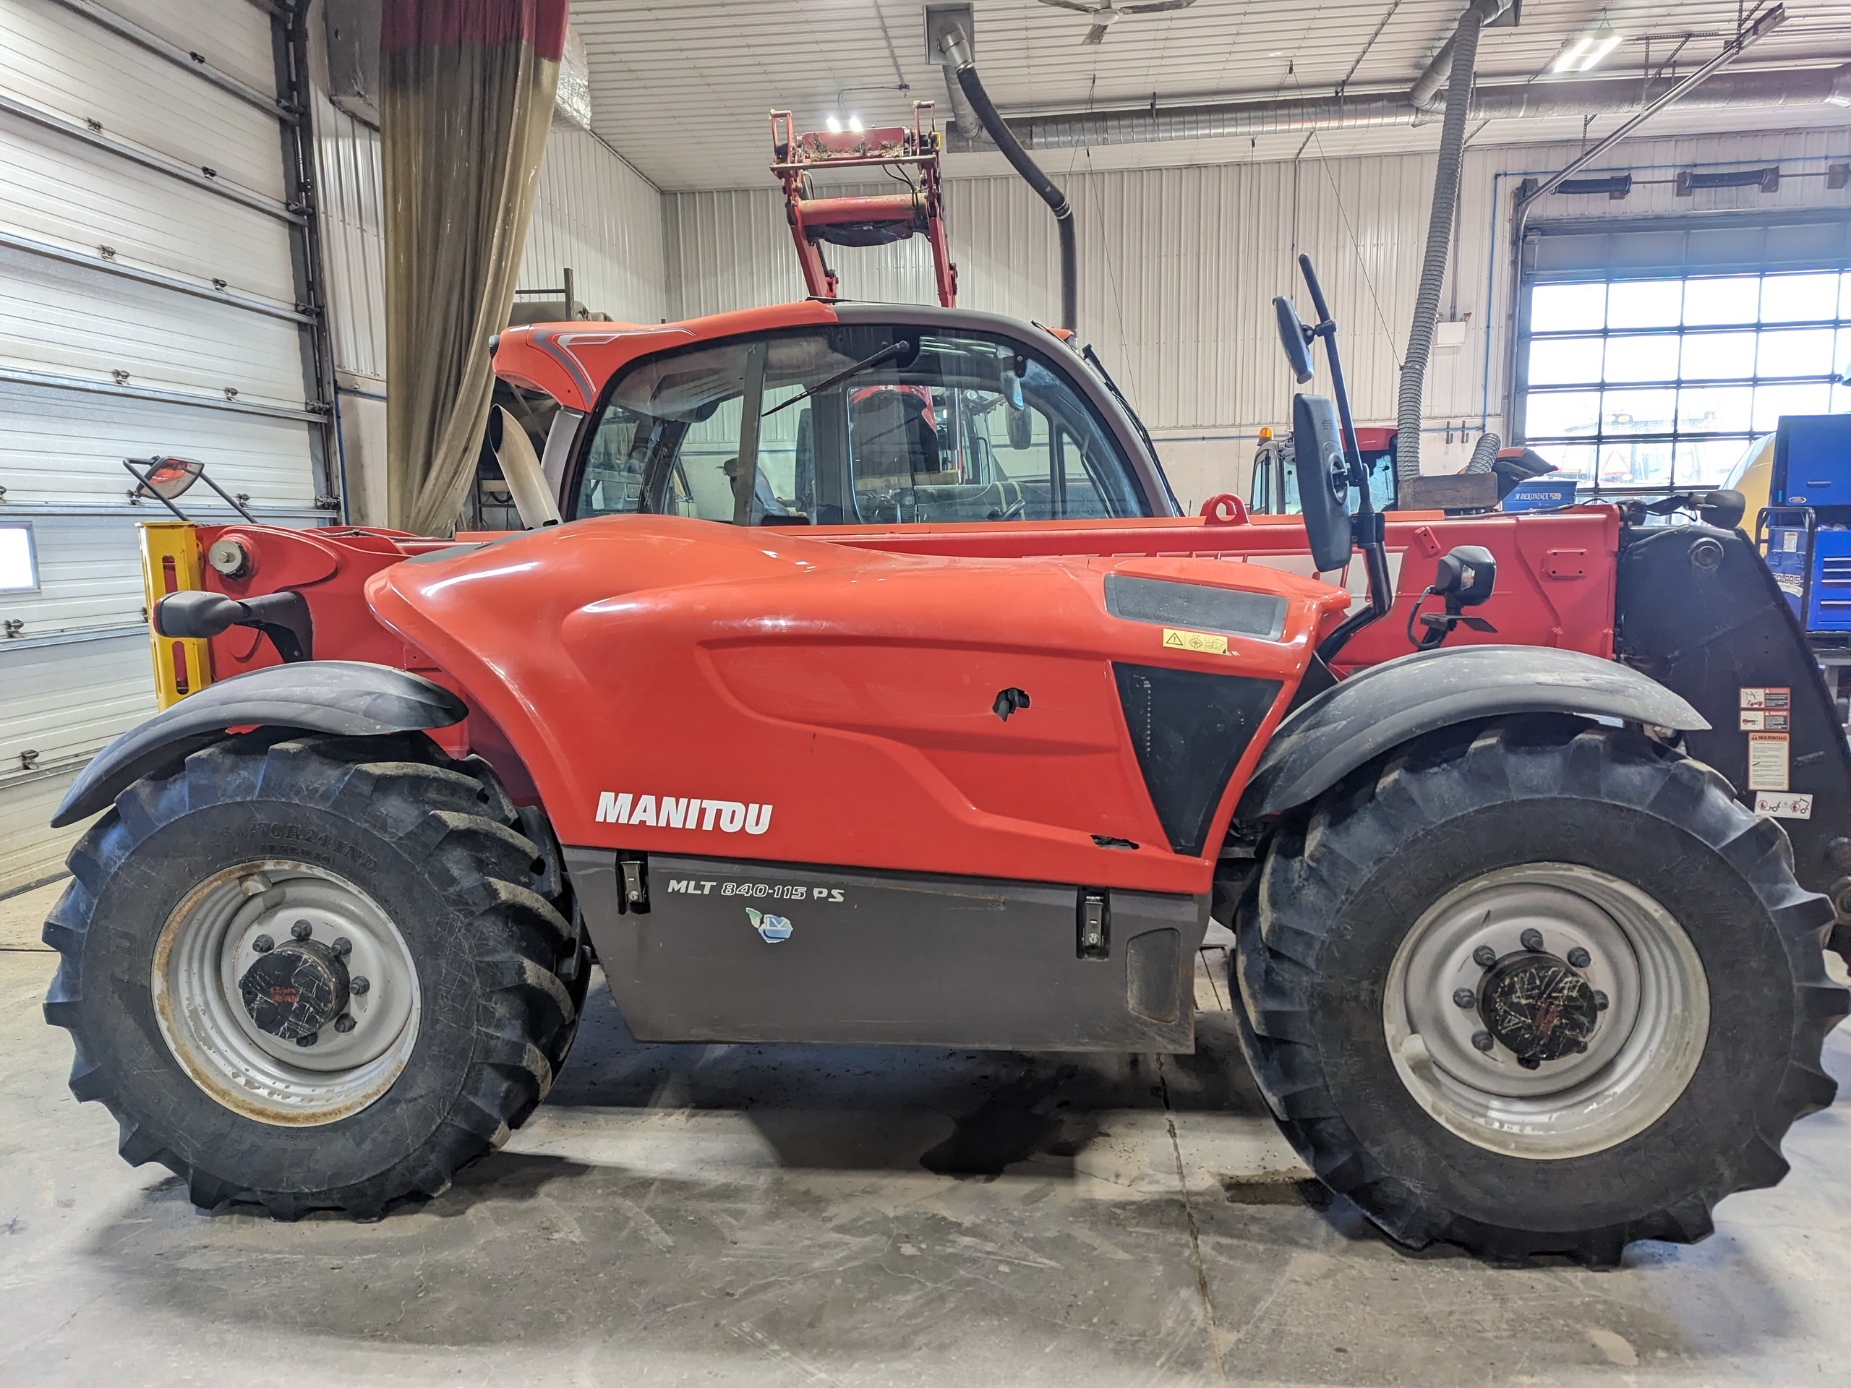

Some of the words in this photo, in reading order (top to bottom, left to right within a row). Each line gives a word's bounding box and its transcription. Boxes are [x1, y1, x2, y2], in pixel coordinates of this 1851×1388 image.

[595, 791, 773, 835] MANITOU
[667, 880, 716, 895] MLT
[721, 882, 807, 899] 840-115
[813, 887, 845, 902] PS
